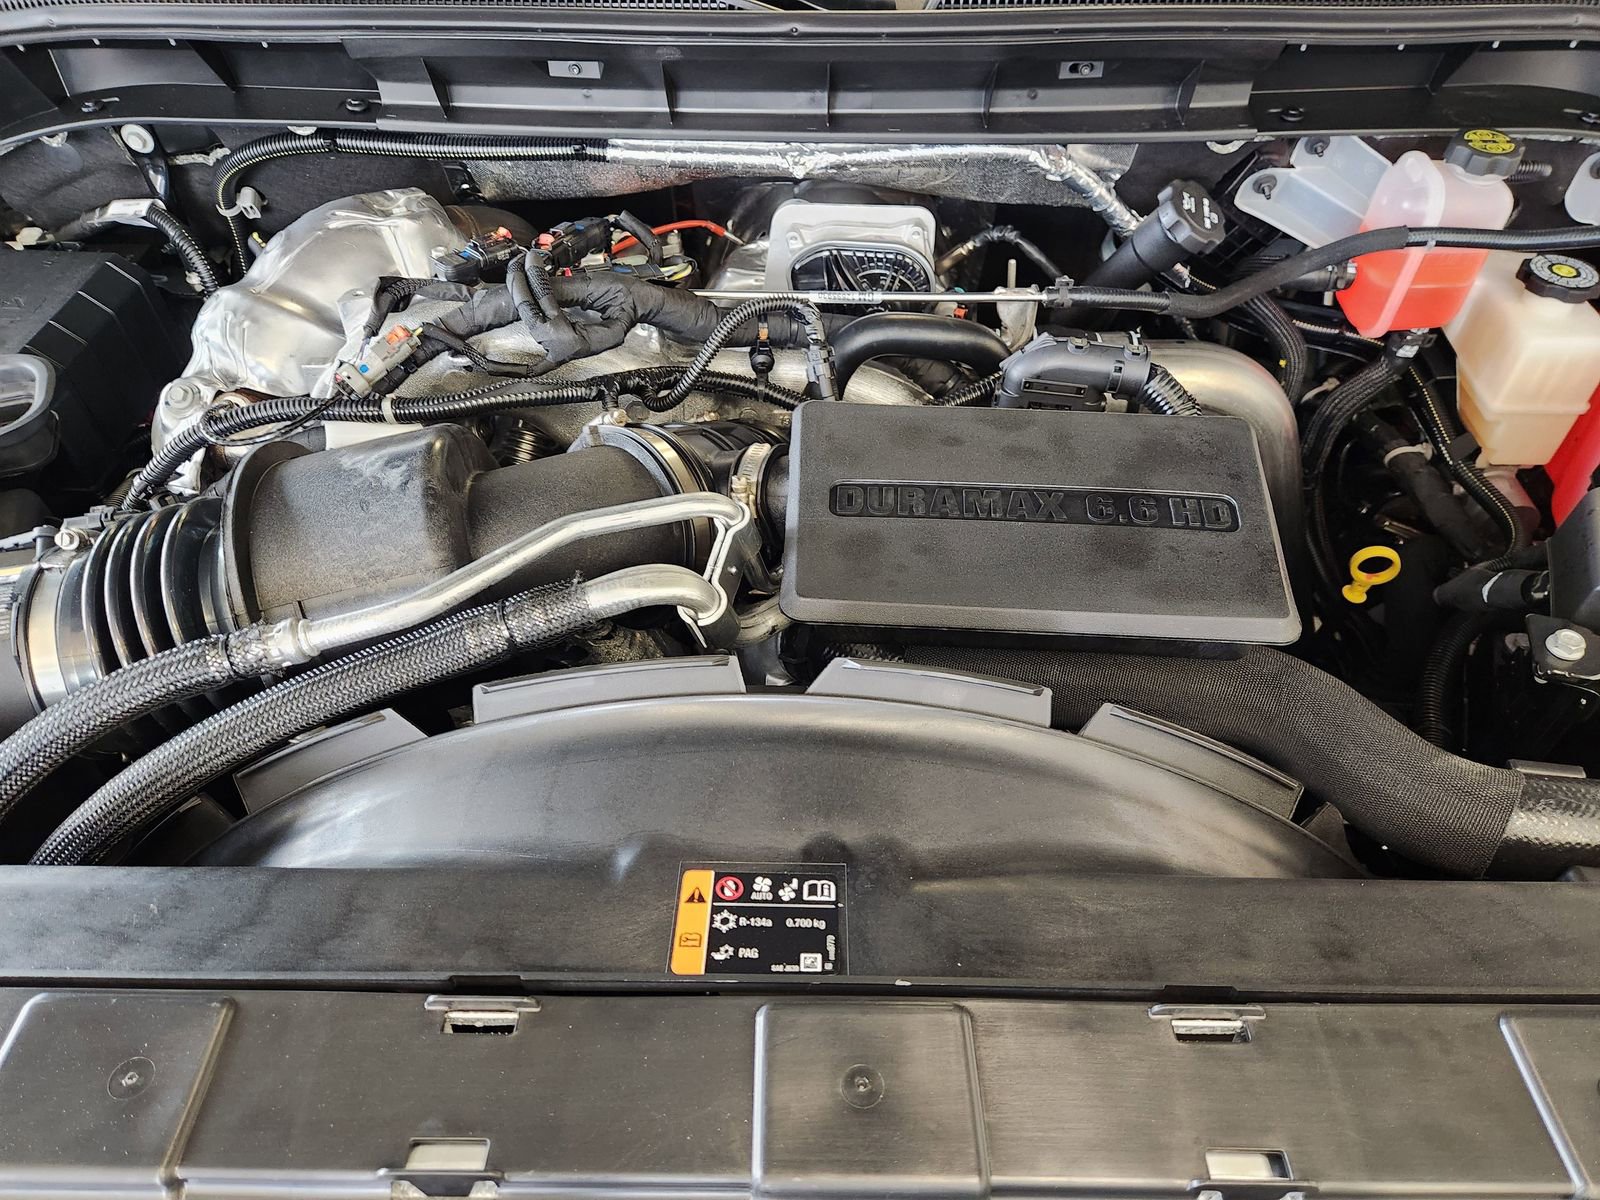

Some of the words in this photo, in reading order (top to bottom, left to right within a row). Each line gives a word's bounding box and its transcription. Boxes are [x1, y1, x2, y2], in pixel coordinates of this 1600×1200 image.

[835, 485, 1068, 521] DURAMAX
[1084, 493, 1160, 525] 6.6
[1170, 497, 1232, 529] HD
[750, 890, 774, 901] AUTO
[738, 916, 773, 928] R-134a
[785, 917, 812, 929] 0.700
[813, 917, 827, 930] kg
[737, 946, 760, 959] PAG
